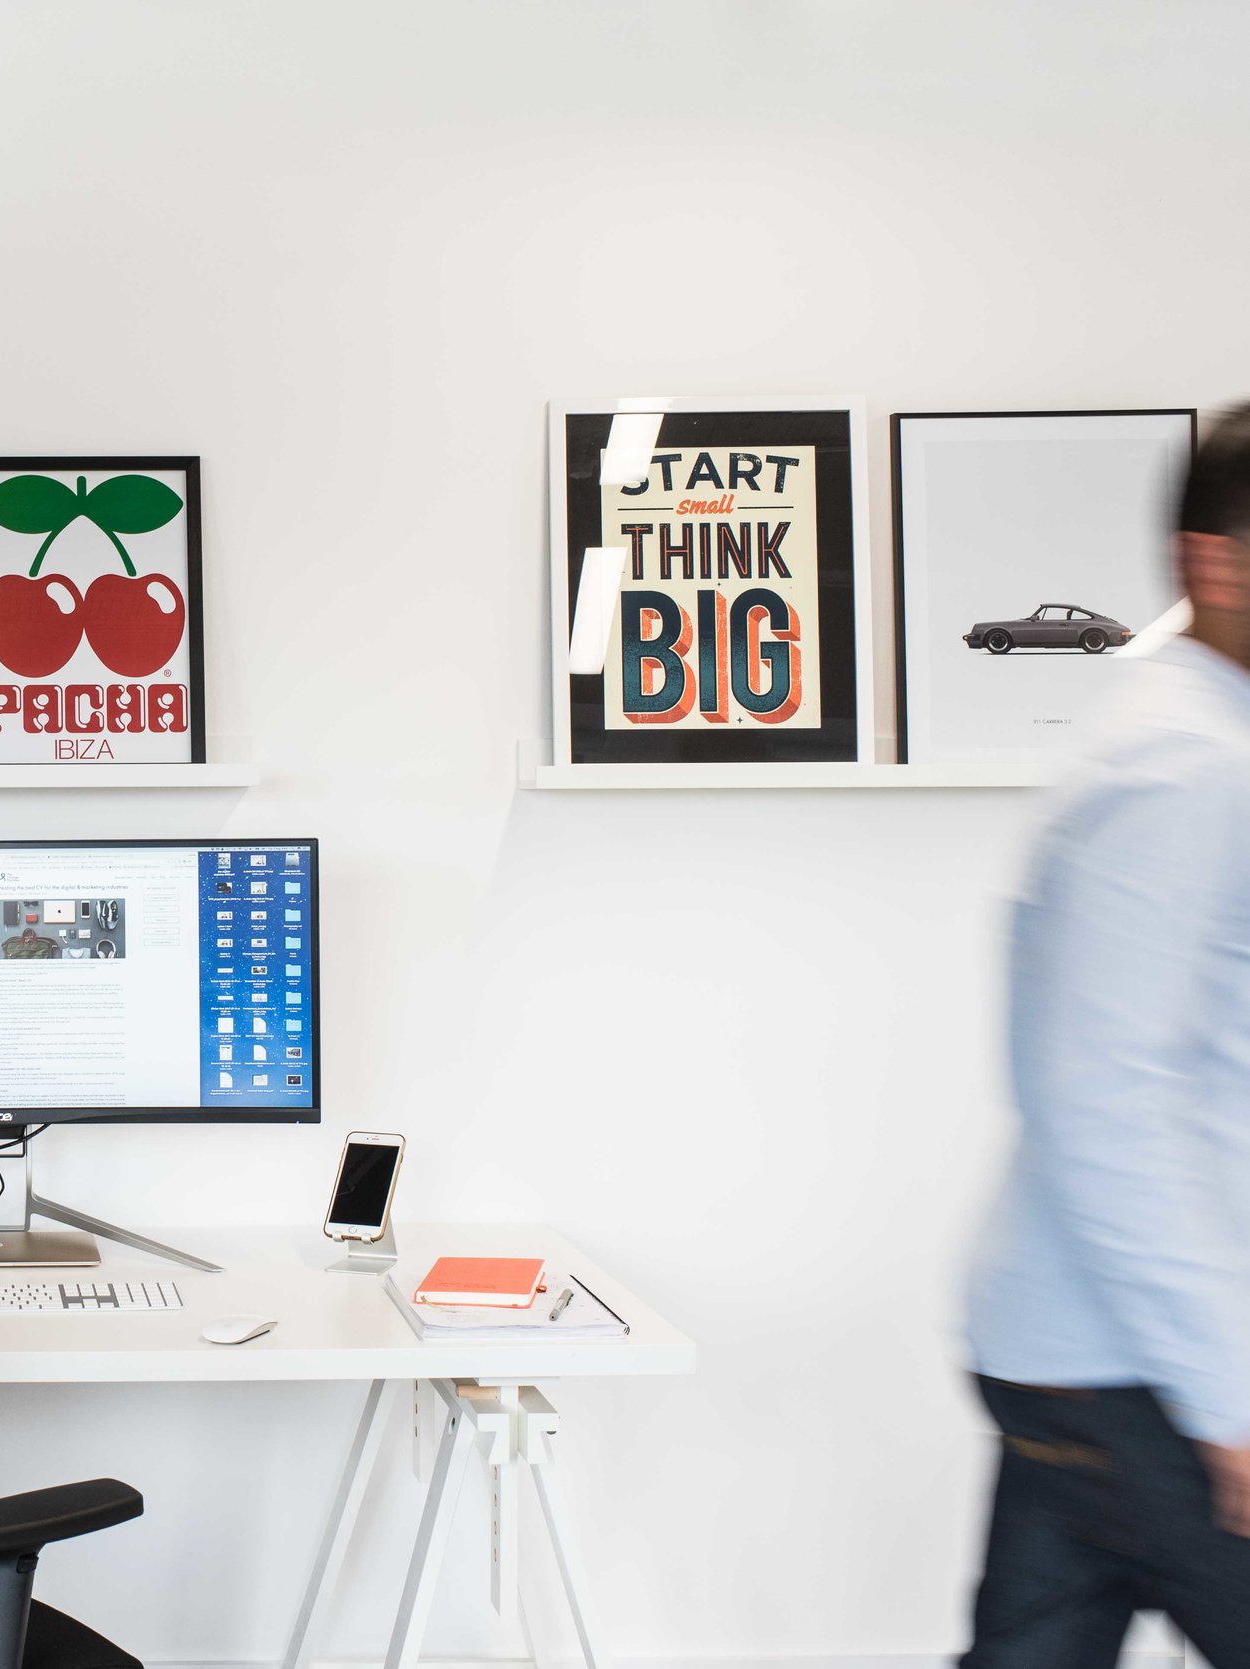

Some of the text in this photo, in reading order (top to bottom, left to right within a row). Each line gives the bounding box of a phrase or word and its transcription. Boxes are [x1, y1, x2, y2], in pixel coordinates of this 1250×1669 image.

[676, 494, 735, 515] small
[620, 521, 792, 580] THINK
[620, 587, 801, 725] BIG
[54, 739, 114, 760] IBIZA
